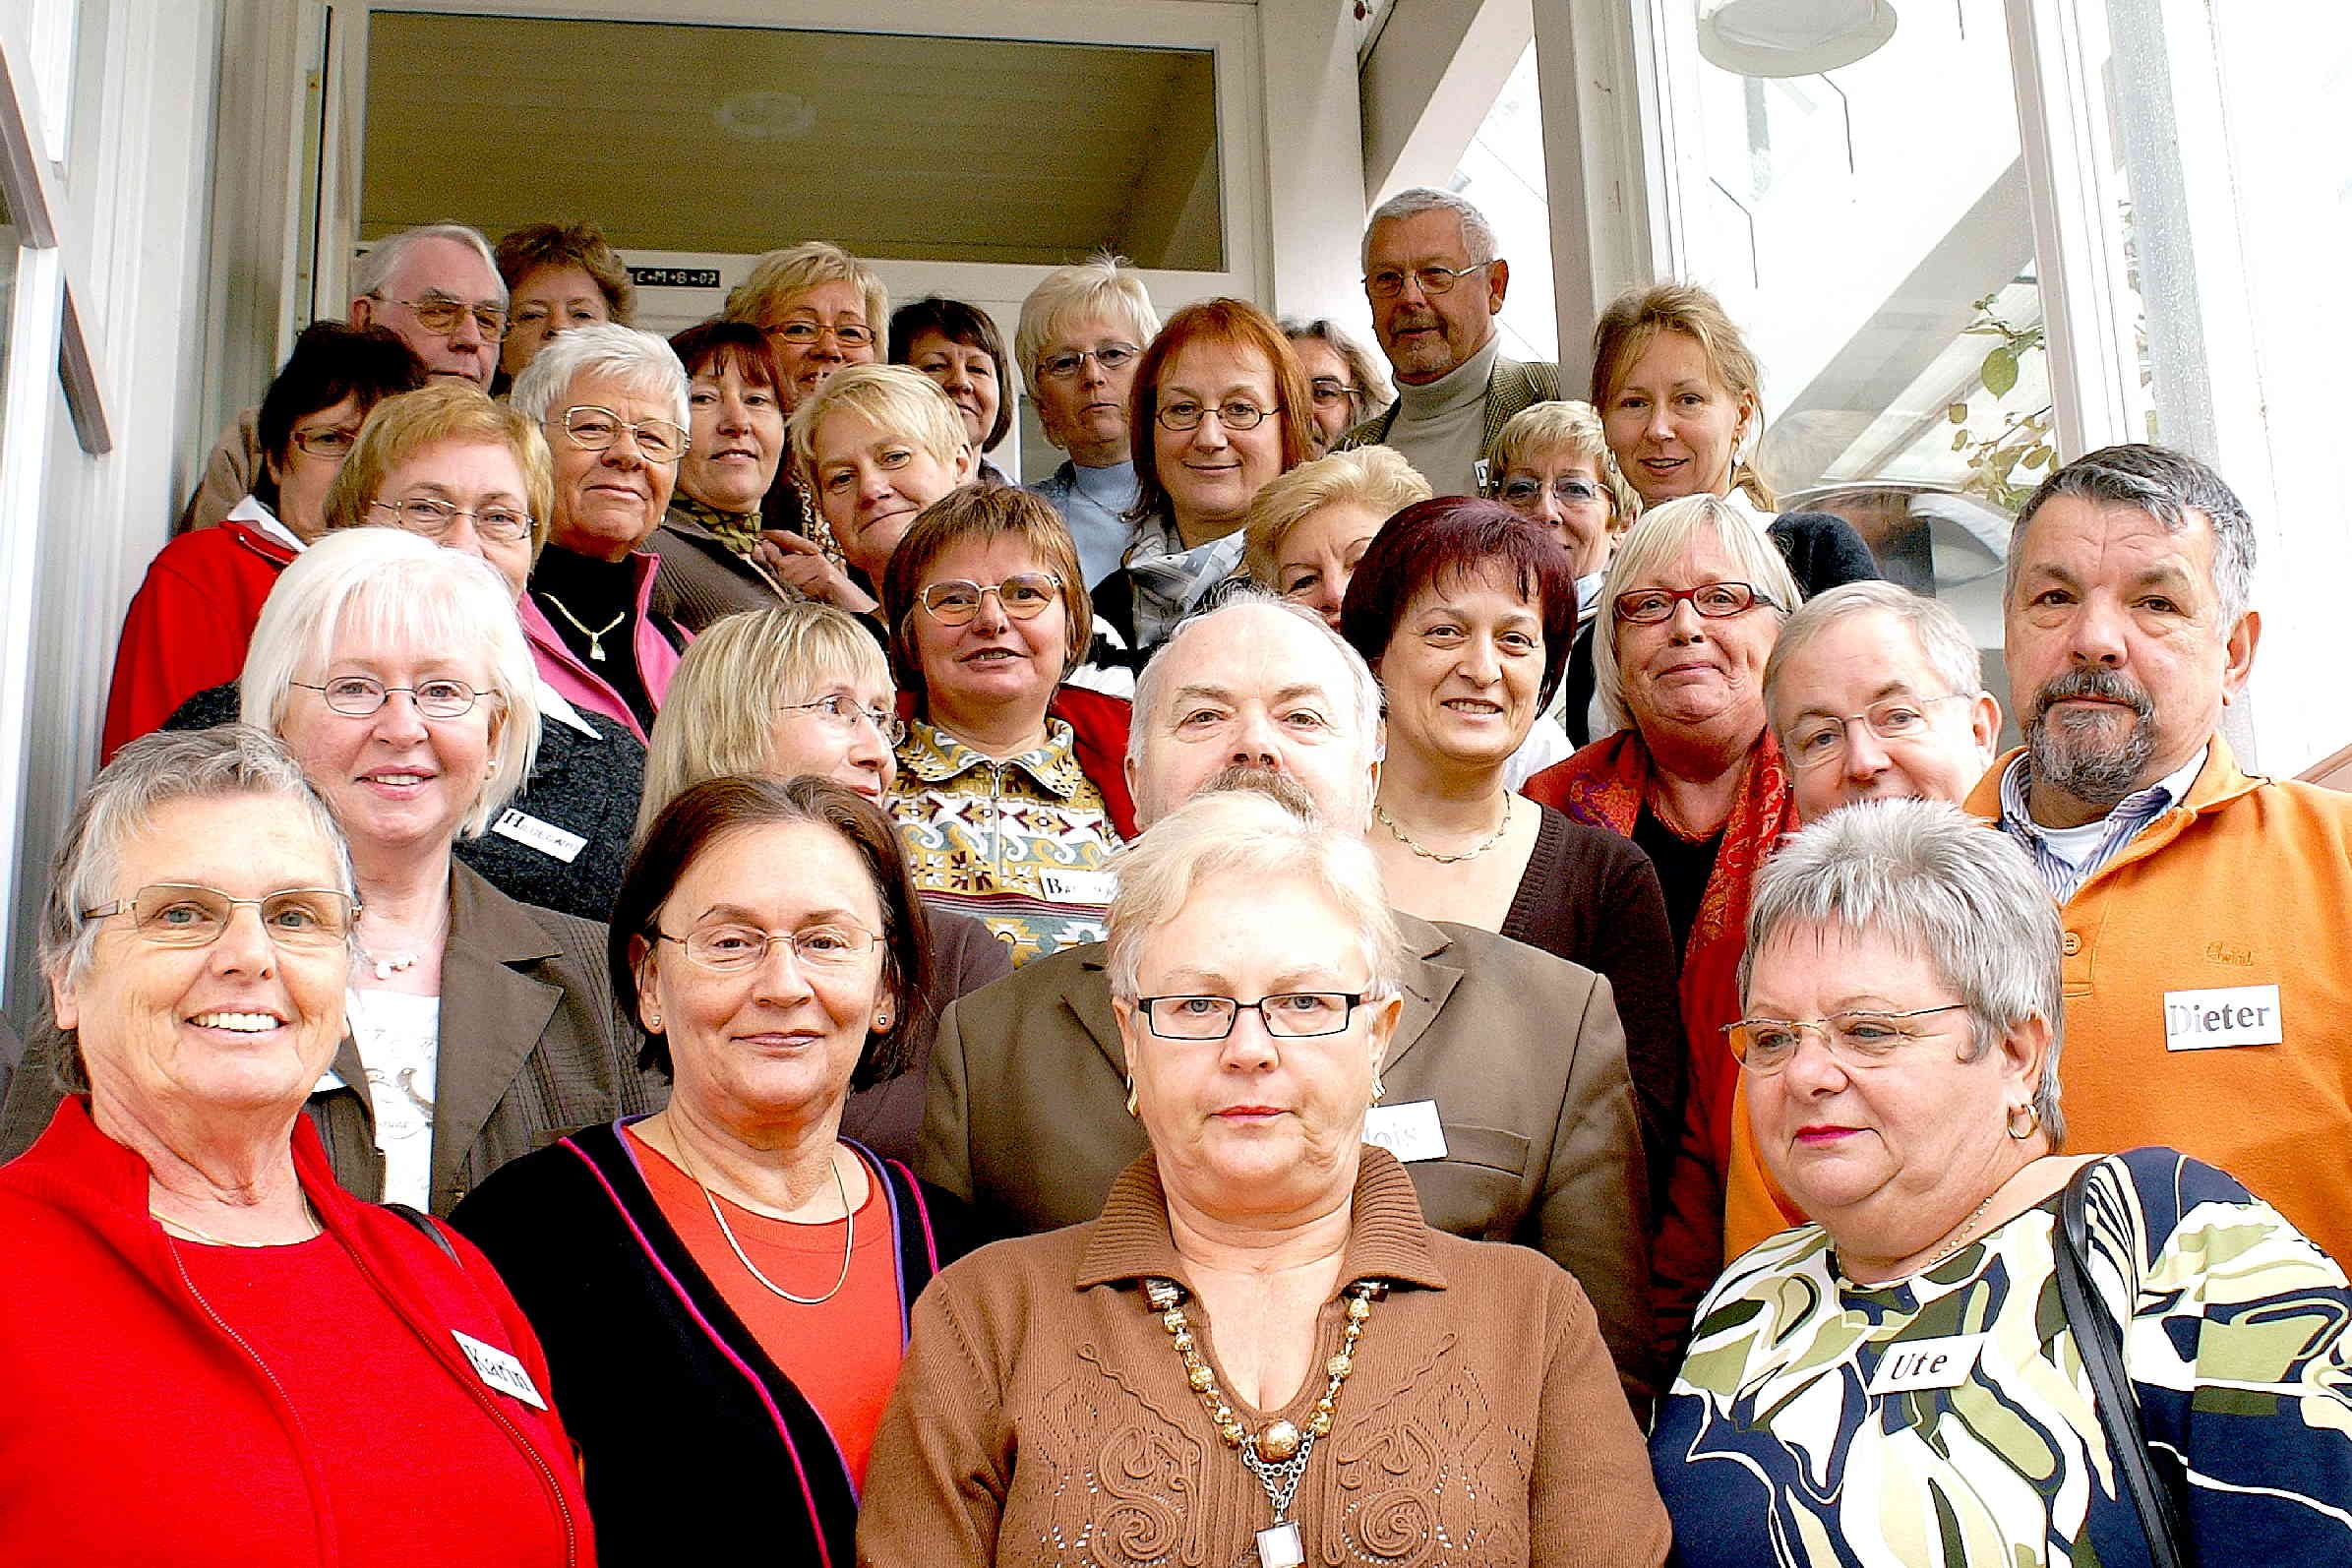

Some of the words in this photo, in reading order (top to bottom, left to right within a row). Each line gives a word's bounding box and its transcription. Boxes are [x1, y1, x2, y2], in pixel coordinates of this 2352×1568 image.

[2169, 1003, 2270, 1037] Dieter
[463, 1344, 532, 1393] Karin
[1891, 1352, 1948, 1380] Ute
